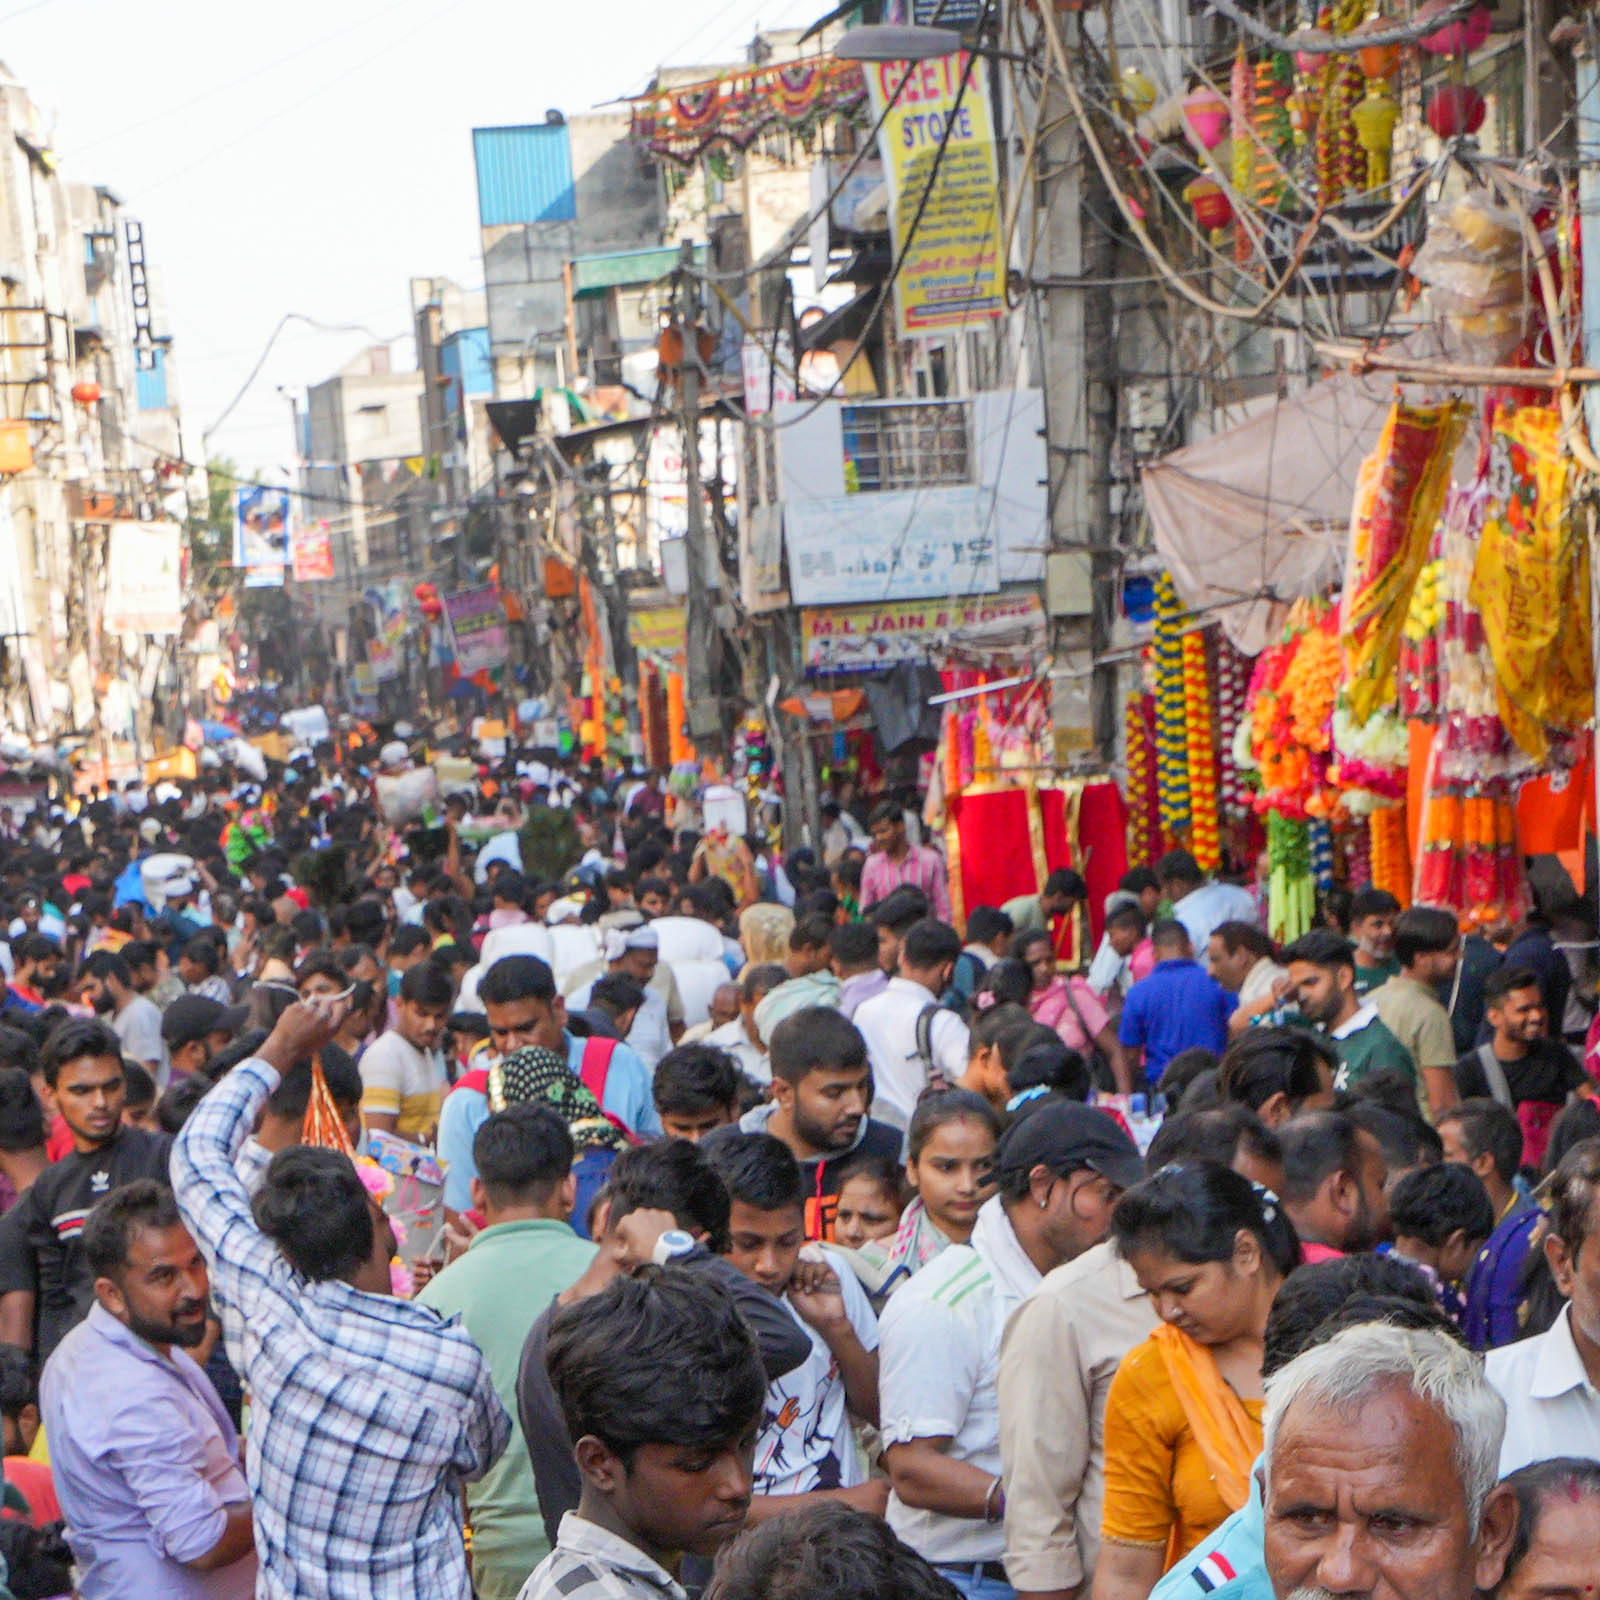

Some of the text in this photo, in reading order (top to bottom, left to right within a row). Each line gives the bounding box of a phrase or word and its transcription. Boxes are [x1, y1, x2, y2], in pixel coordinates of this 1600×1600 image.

[880, 50, 979, 107] GEETA
[903, 108, 973, 148] STORE
[812, 615, 857, 637] M.L
[865, 613, 926, 635] JAIN
